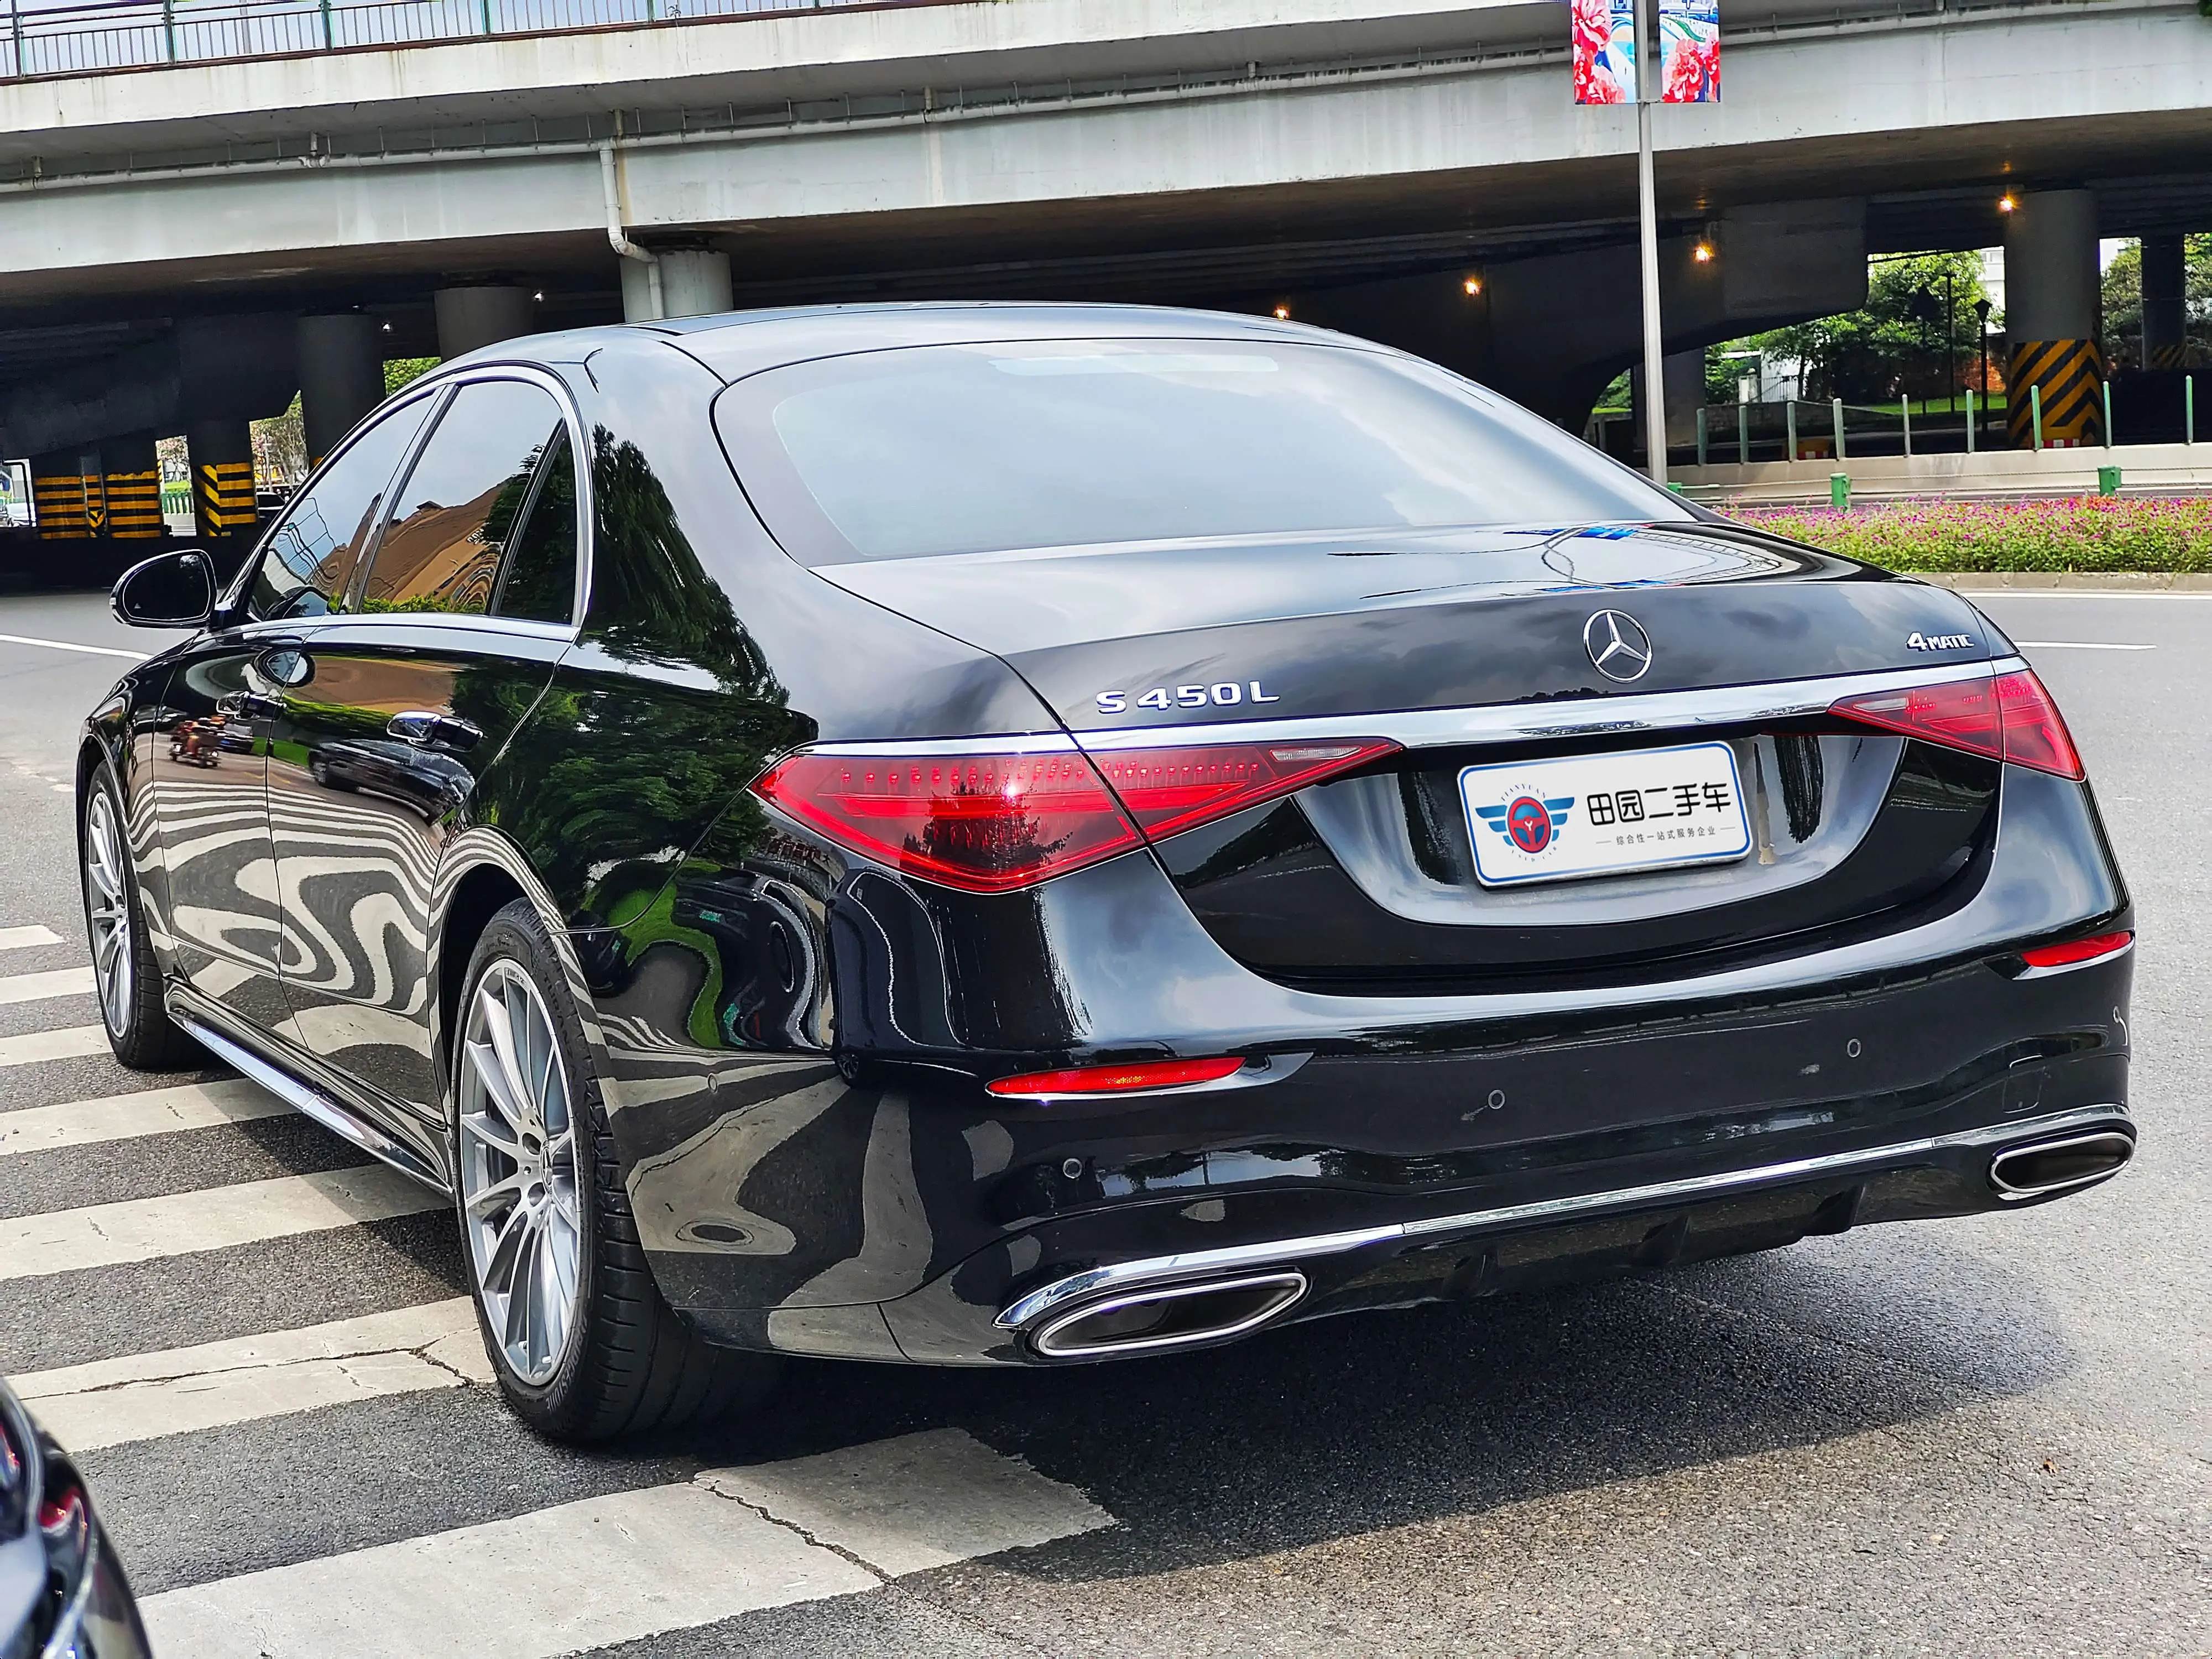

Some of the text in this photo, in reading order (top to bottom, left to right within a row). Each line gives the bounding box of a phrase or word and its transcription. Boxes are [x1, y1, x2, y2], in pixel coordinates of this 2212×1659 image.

[1906, 631, 1975, 651] 4MATIC
[1095, 690, 1127, 714] S
[1587, 782, 1731, 826] 田园二手车
[1616, 826, 1716, 846] 综合性一站式服务企业
